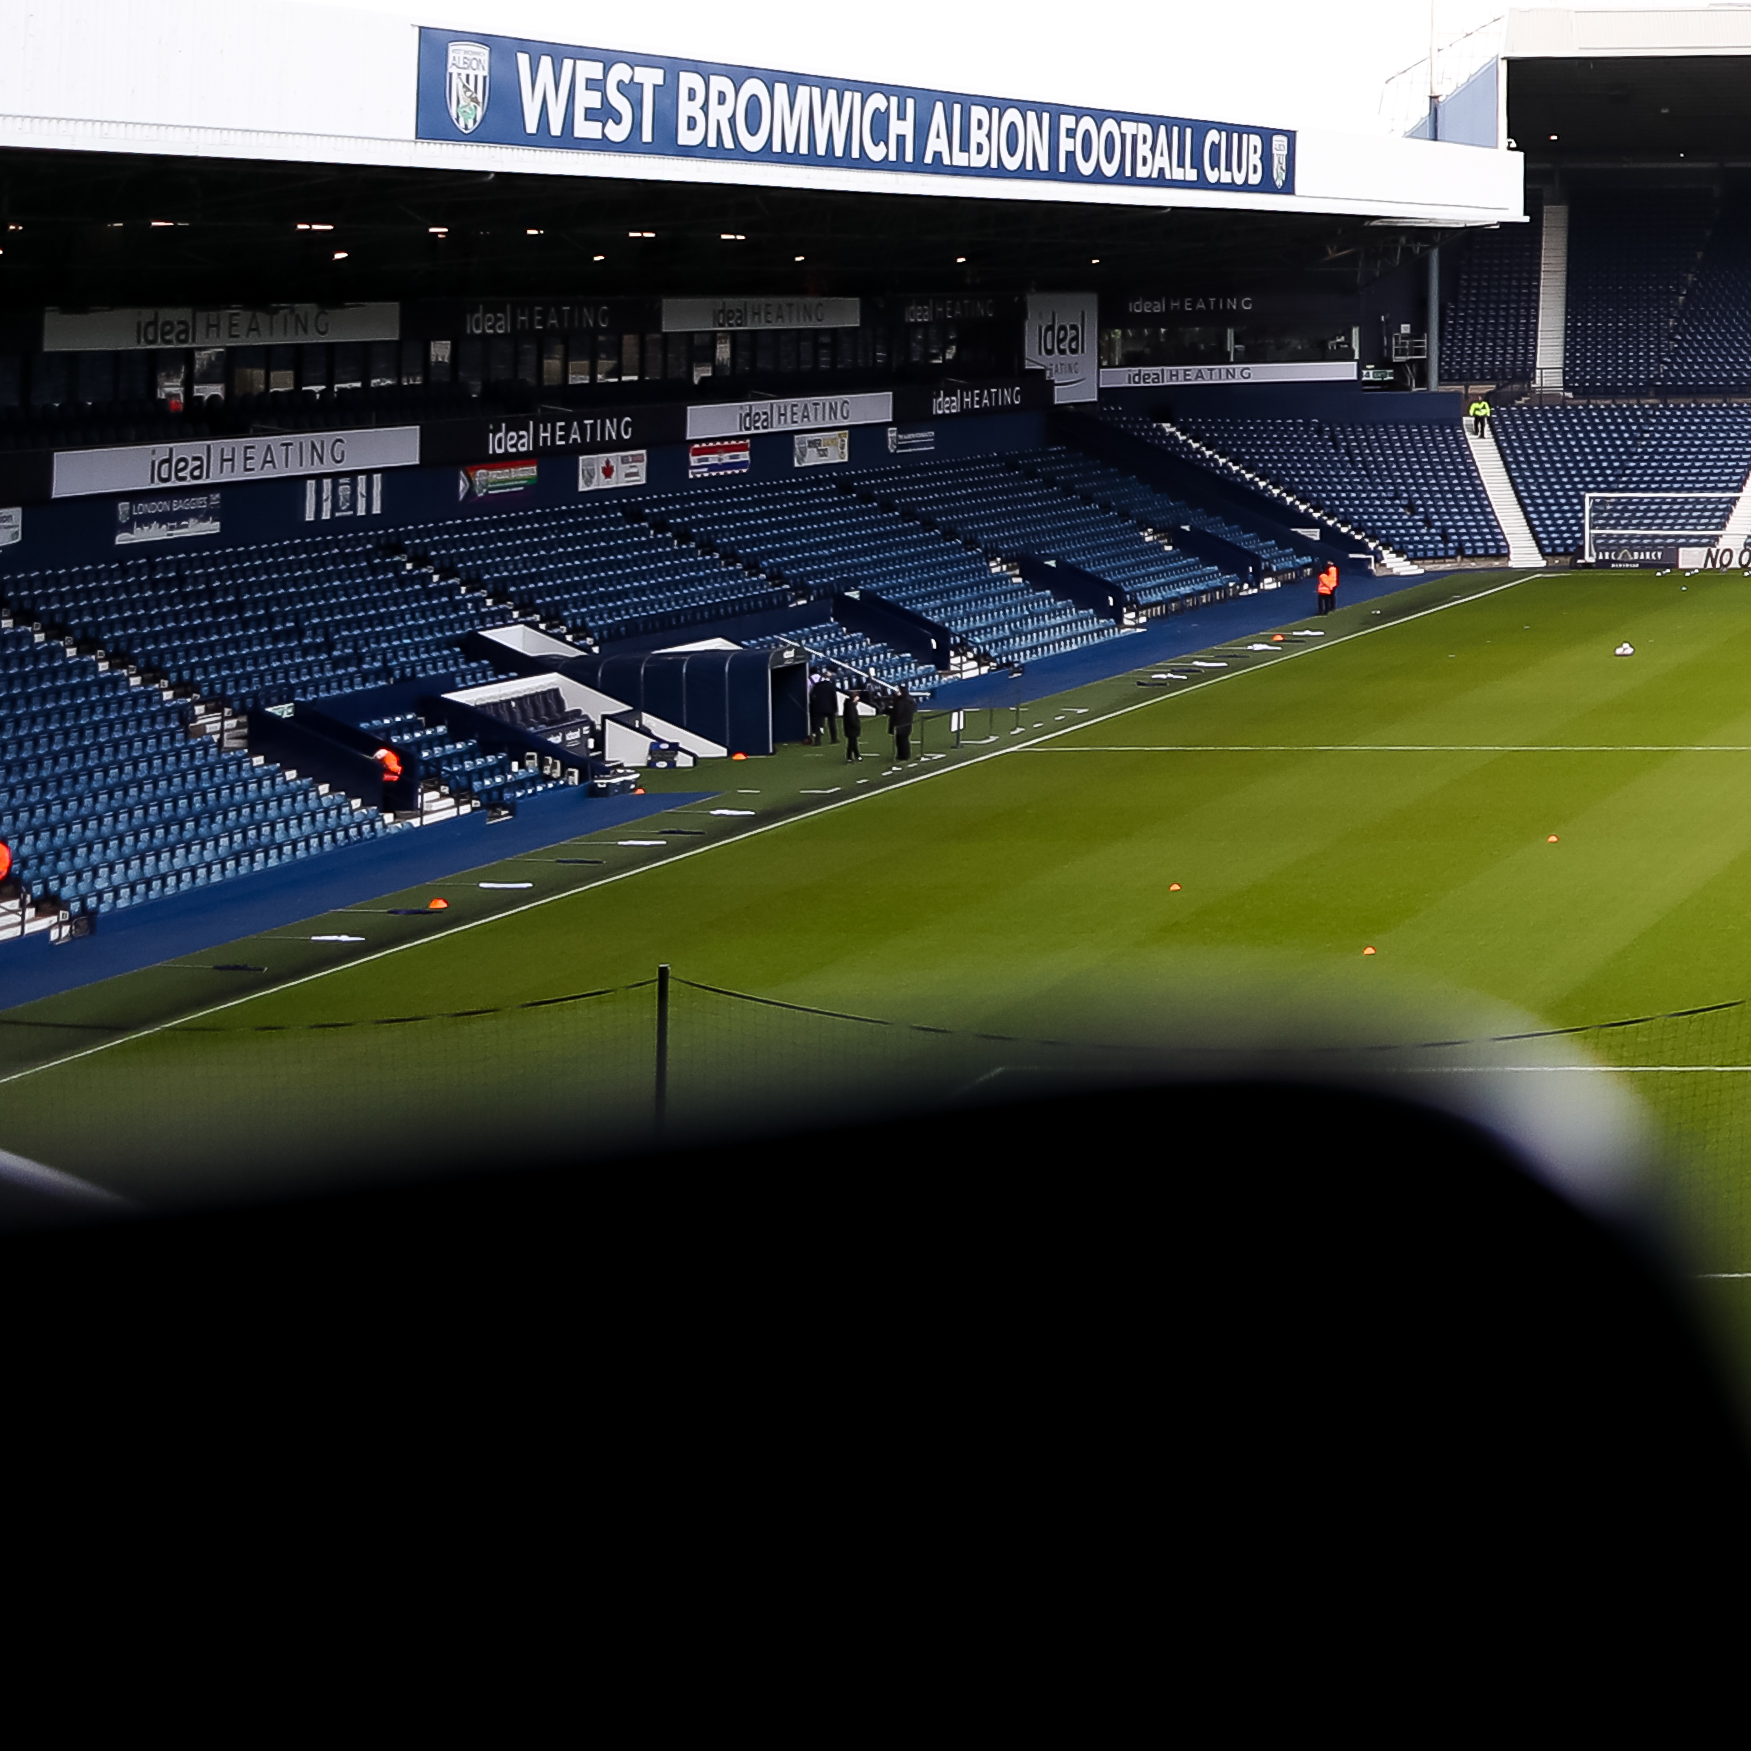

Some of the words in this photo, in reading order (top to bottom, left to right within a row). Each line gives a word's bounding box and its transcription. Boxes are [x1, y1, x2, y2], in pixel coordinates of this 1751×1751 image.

[516, 51, 664, 143] WEST
[676, 70, 915, 163] BROMWICH
[924, 101, 1049, 172] ALBION
[1059, 113, 1197, 181] FOOTBALL
[1204, 129, 1262, 186] CLUB
[466, 303, 511, 336] ideal
[520, 305, 609, 330] HEATING
[752, 301, 826, 324] HEATING
[1129, 297, 1165, 313] ideal
[1170, 297, 1252, 312] HEATING
[137, 311, 196, 346] ideal
[205, 308, 329, 338] HEATING
[1038, 310, 1086, 356] ideal
[1127, 369, 1164, 386] ideal
[1169, 366, 1252, 383] HEATING
[932, 390, 961, 415] ideal
[964, 387, 1021, 410] HEATING
[740, 406, 774, 431] ideal
[777, 401, 851, 425] HEATING
[489, 422, 534, 455] ideal
[540, 416, 633, 448] HEATING
[150, 444, 211, 485] ideal
[220, 439, 346, 474] HEATING
[132, 501, 170, 515] LONDON
[1596, 551, 1617, 560] ARC
[1703, 548, 1733, 569] NO
